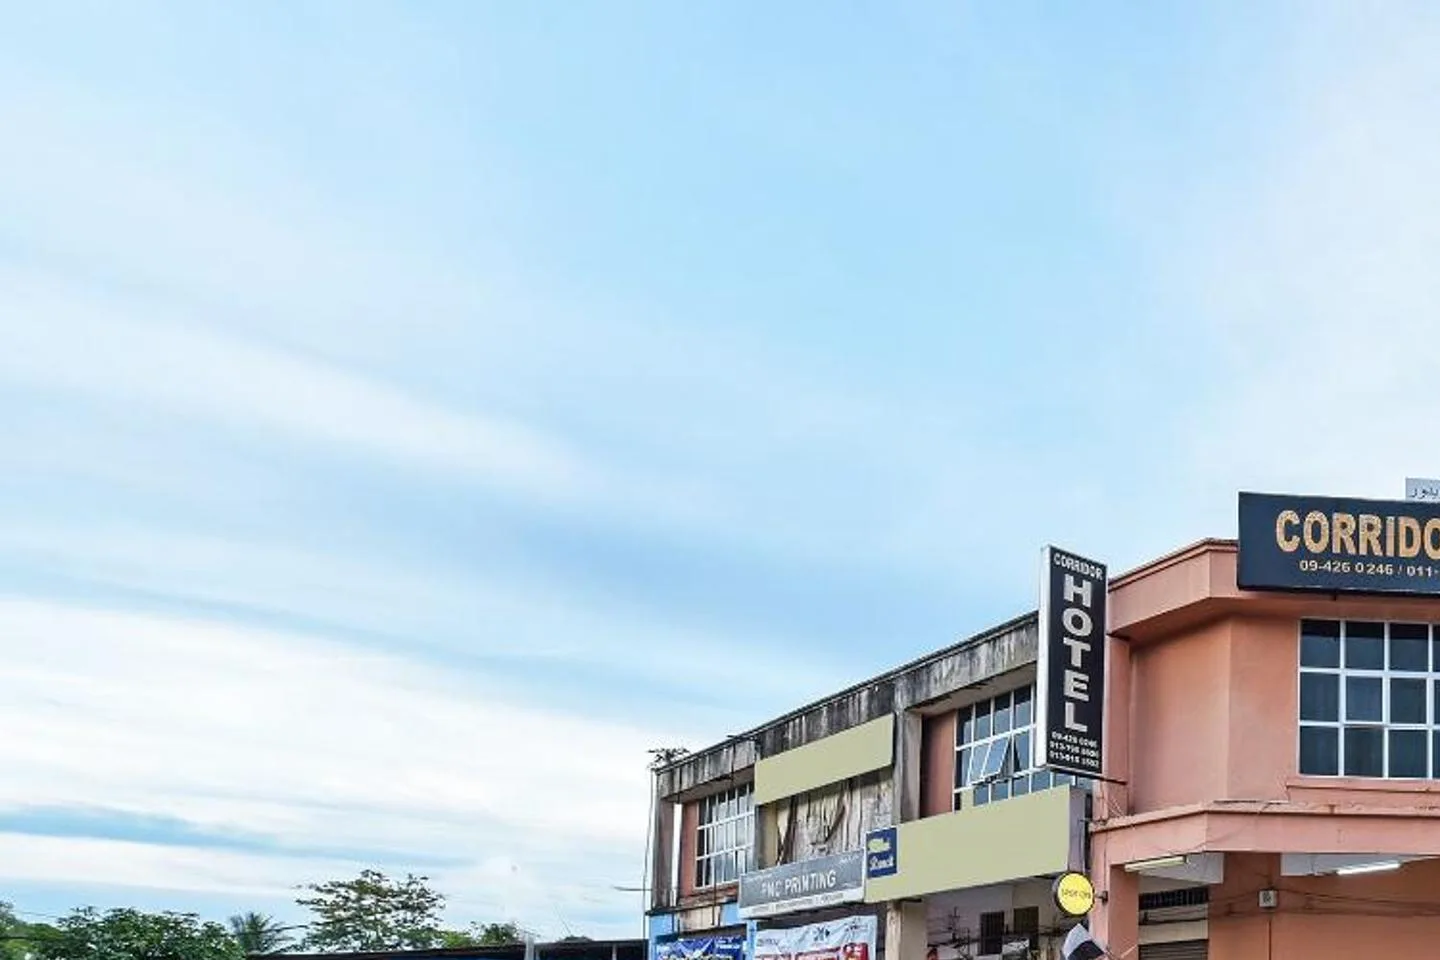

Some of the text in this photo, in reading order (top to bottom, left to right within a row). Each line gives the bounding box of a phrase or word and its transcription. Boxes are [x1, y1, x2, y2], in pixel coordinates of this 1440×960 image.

[1053, 552, 1103, 581] CORRIDOR
[1299, 559, 1351, 574] 09-426
[1355, 561, 1394, 576] 0246
[1062, 573, 1093, 733] HOTEL
[784, 869, 837, 895] PRINTING
